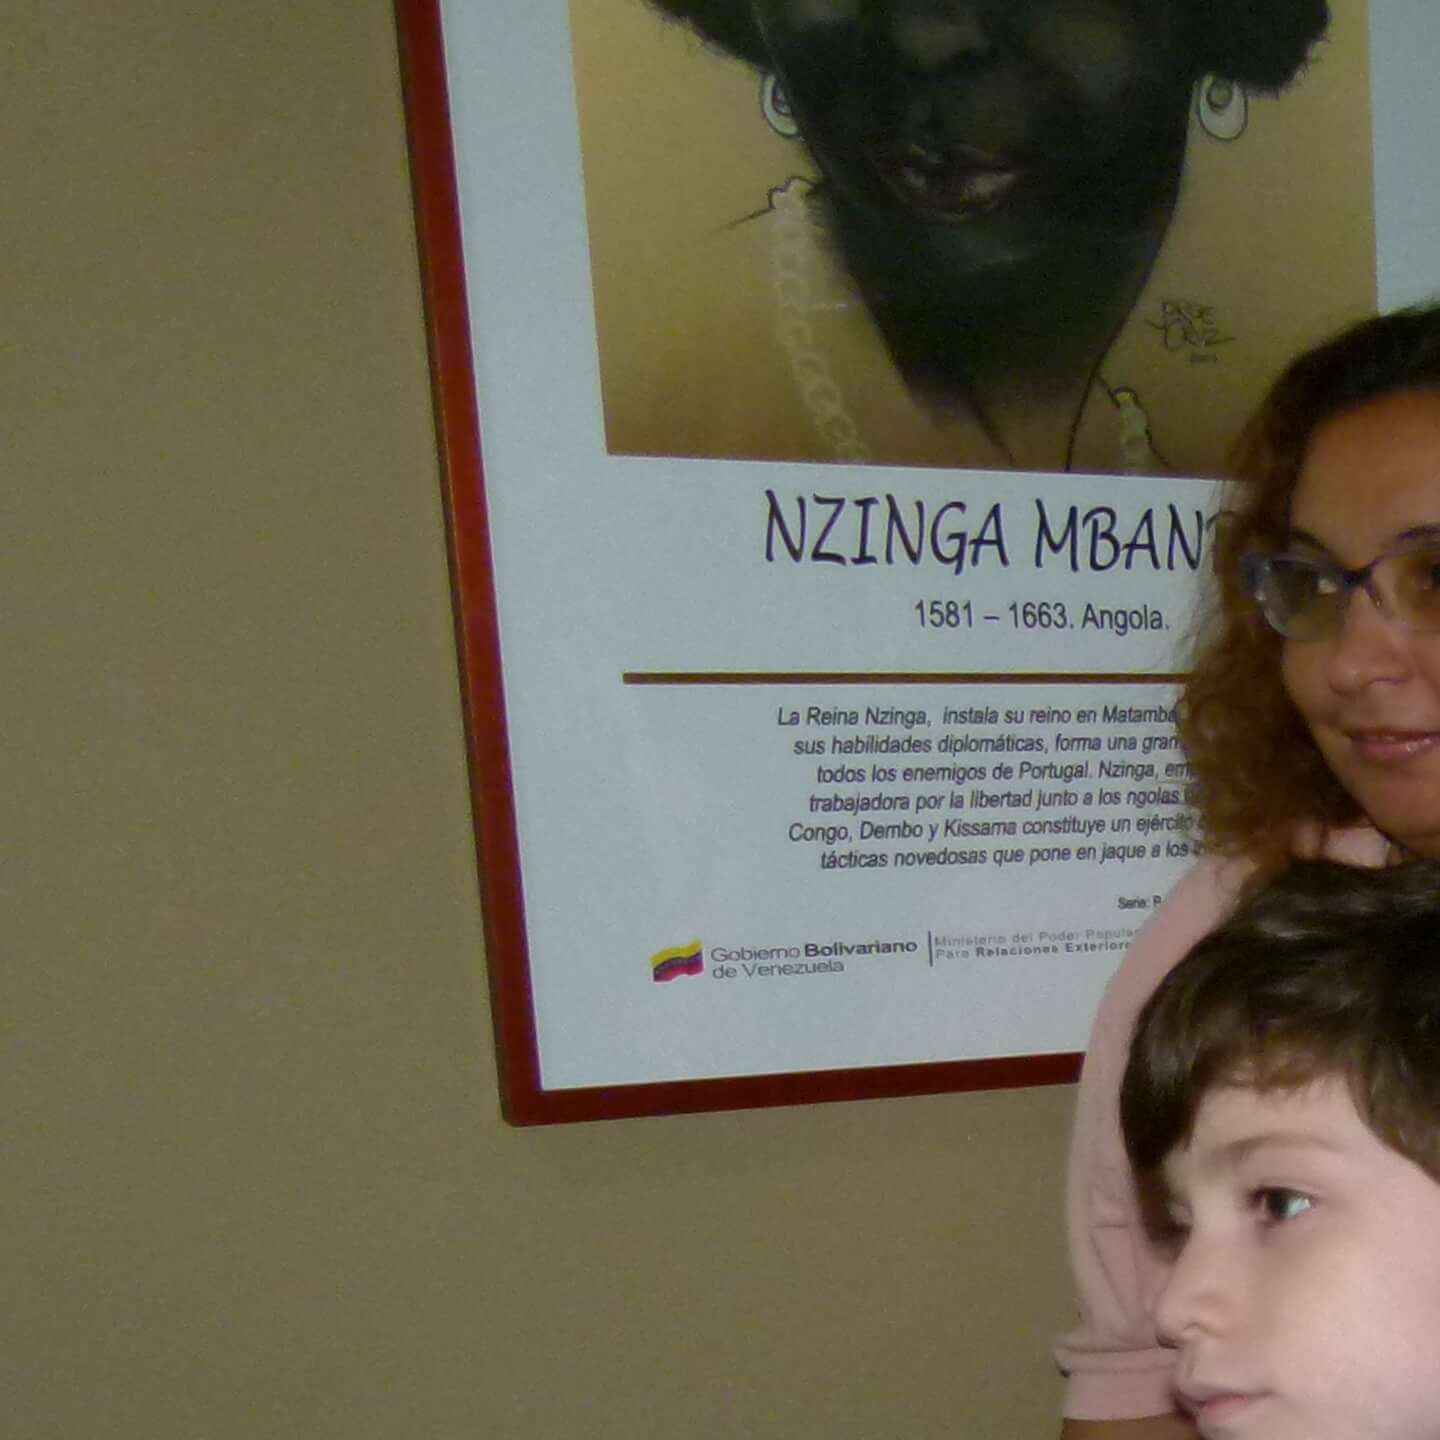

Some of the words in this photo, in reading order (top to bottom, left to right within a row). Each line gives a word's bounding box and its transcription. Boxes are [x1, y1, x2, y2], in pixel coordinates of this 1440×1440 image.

[765, 489, 1010, 575] NZINGA
[915, 601, 973, 628] 1581
[1009, 602, 1075, 630] 1663.
[1082, 603, 1170, 636] Angola.
[777, 706, 800, 726] La
[806, 706, 859, 726] Reina
[865, 706, 932, 729] Nzinga,
[943, 706, 999, 725] instala
[1003, 709, 1024, 724] su
[1029, 706, 1071, 724] reino
[1077, 709, 1097, 724] en
[793, 740, 825, 755] sus
[831, 735, 932, 755] habilidades
[938, 733, 1049, 757] diplomáticas,
[1055, 733, 1101, 752] forma
[1107, 736, 1137, 751] una
[817, 764, 866, 783] todos
[871, 763, 897, 782] los
[902, 762, 986, 785] enemigos
[992, 762, 1013, 780] de
[1019, 760, 1093, 783] Portugal.
[1098, 760, 1159, 782] Nzinga,
[809, 792, 910, 816] trabajadora
[915, 794, 945, 814] por
[950, 790, 965, 809] la
[970, 788, 1032, 809] libertad
[1035, 789, 1078, 811] junto
[1082, 791, 1093, 806] a
[1098, 787, 1121, 806] los
[1126, 787, 1180, 808] ngolas
[788, 822, 852, 846] Congo,
[860, 819, 923, 840] Dembo
[928, 822, 939, 842] y
[943, 818, 1016, 838] Kissama
[1022, 814, 1105, 838] constituye
[1110, 816, 1131, 832] un
[821, 850, 888, 870] tácticas
[894, 847, 987, 868] novedosas
[993, 847, 1024, 867] que
[1029, 846, 1074, 866] pone
[1076, 846, 1096, 861] en
[1099, 840, 1146, 865] jaque
[1151, 843, 1161, 859] a
[1165, 839, 1189, 858] los
[710, 944, 800, 963] Gobierno
[804, 939, 918, 957] Bolivariano
[934, 933, 1007, 947] Ministerio
[1012, 931, 1033, 944] del
[975, 943, 1059, 958] Relaciones
[711, 963, 737, 979] de
[741, 959, 844, 977] Venezuela
